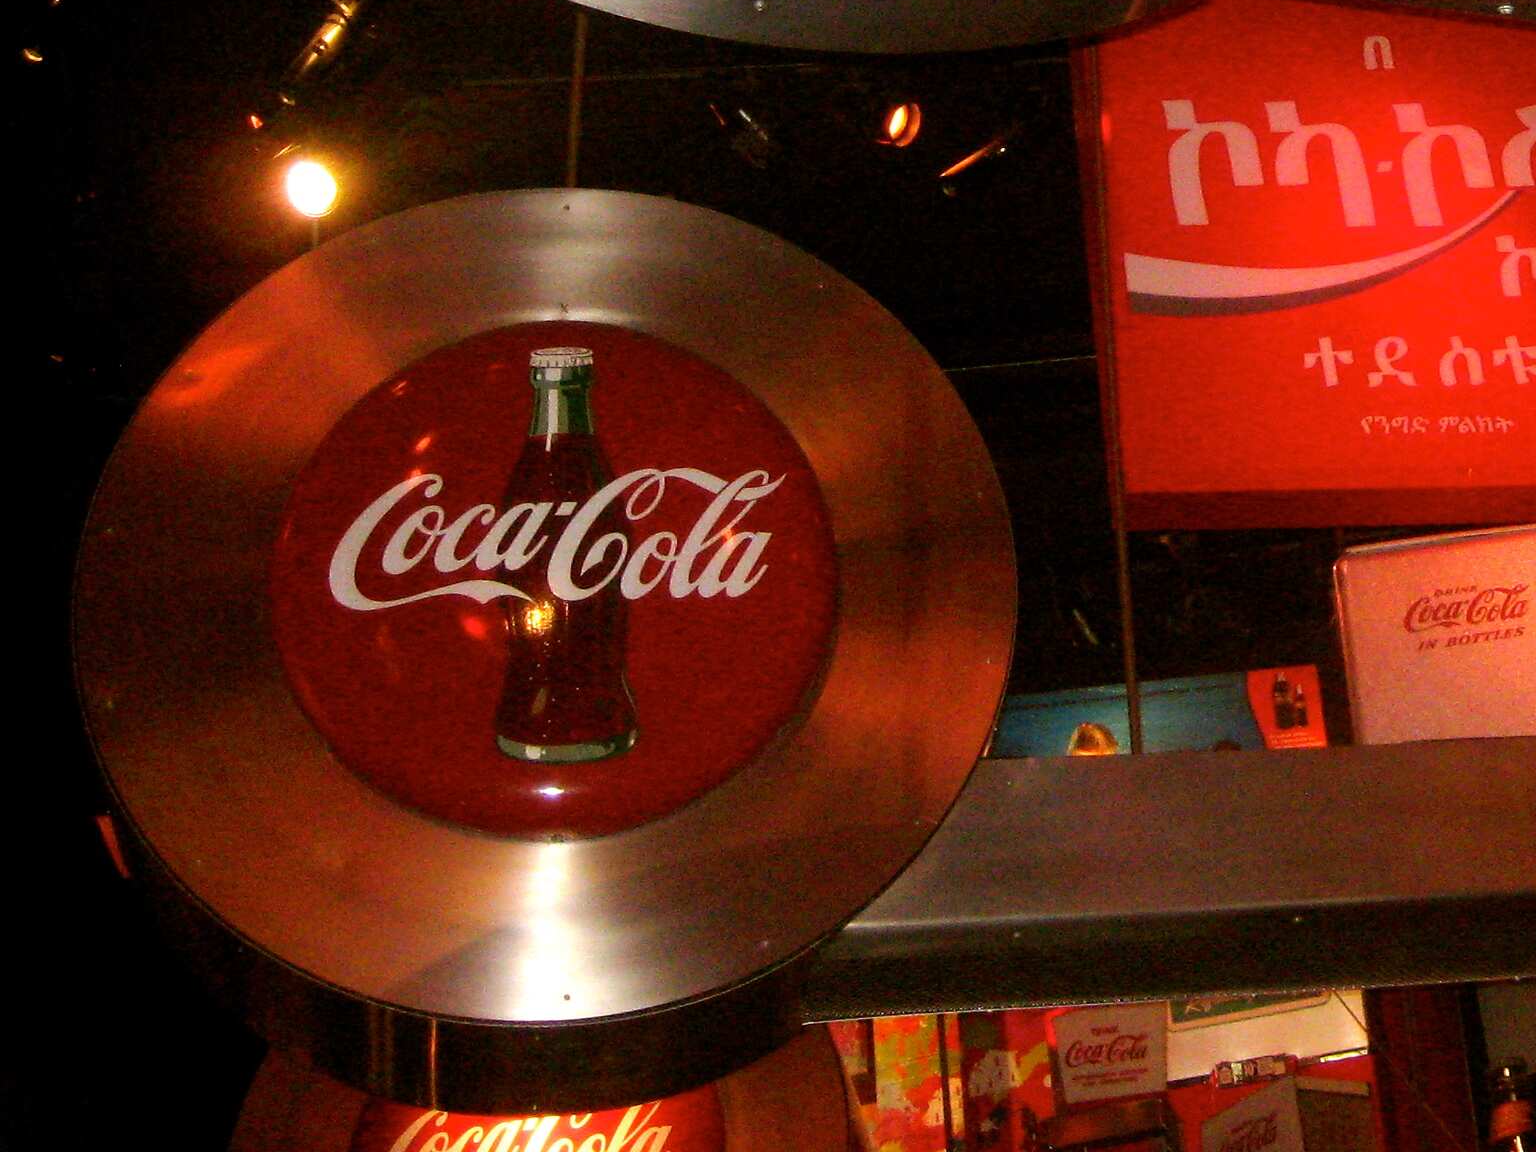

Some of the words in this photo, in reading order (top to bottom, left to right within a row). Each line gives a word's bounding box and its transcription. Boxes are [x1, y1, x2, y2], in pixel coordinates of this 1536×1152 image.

[329, 468, 787, 611] Coca-Cola
[1403, 583, 1529, 634] Coca-Cola
[1418, 639, 1438, 651] IN
[1446, 626, 1527, 648] BOTTLES
